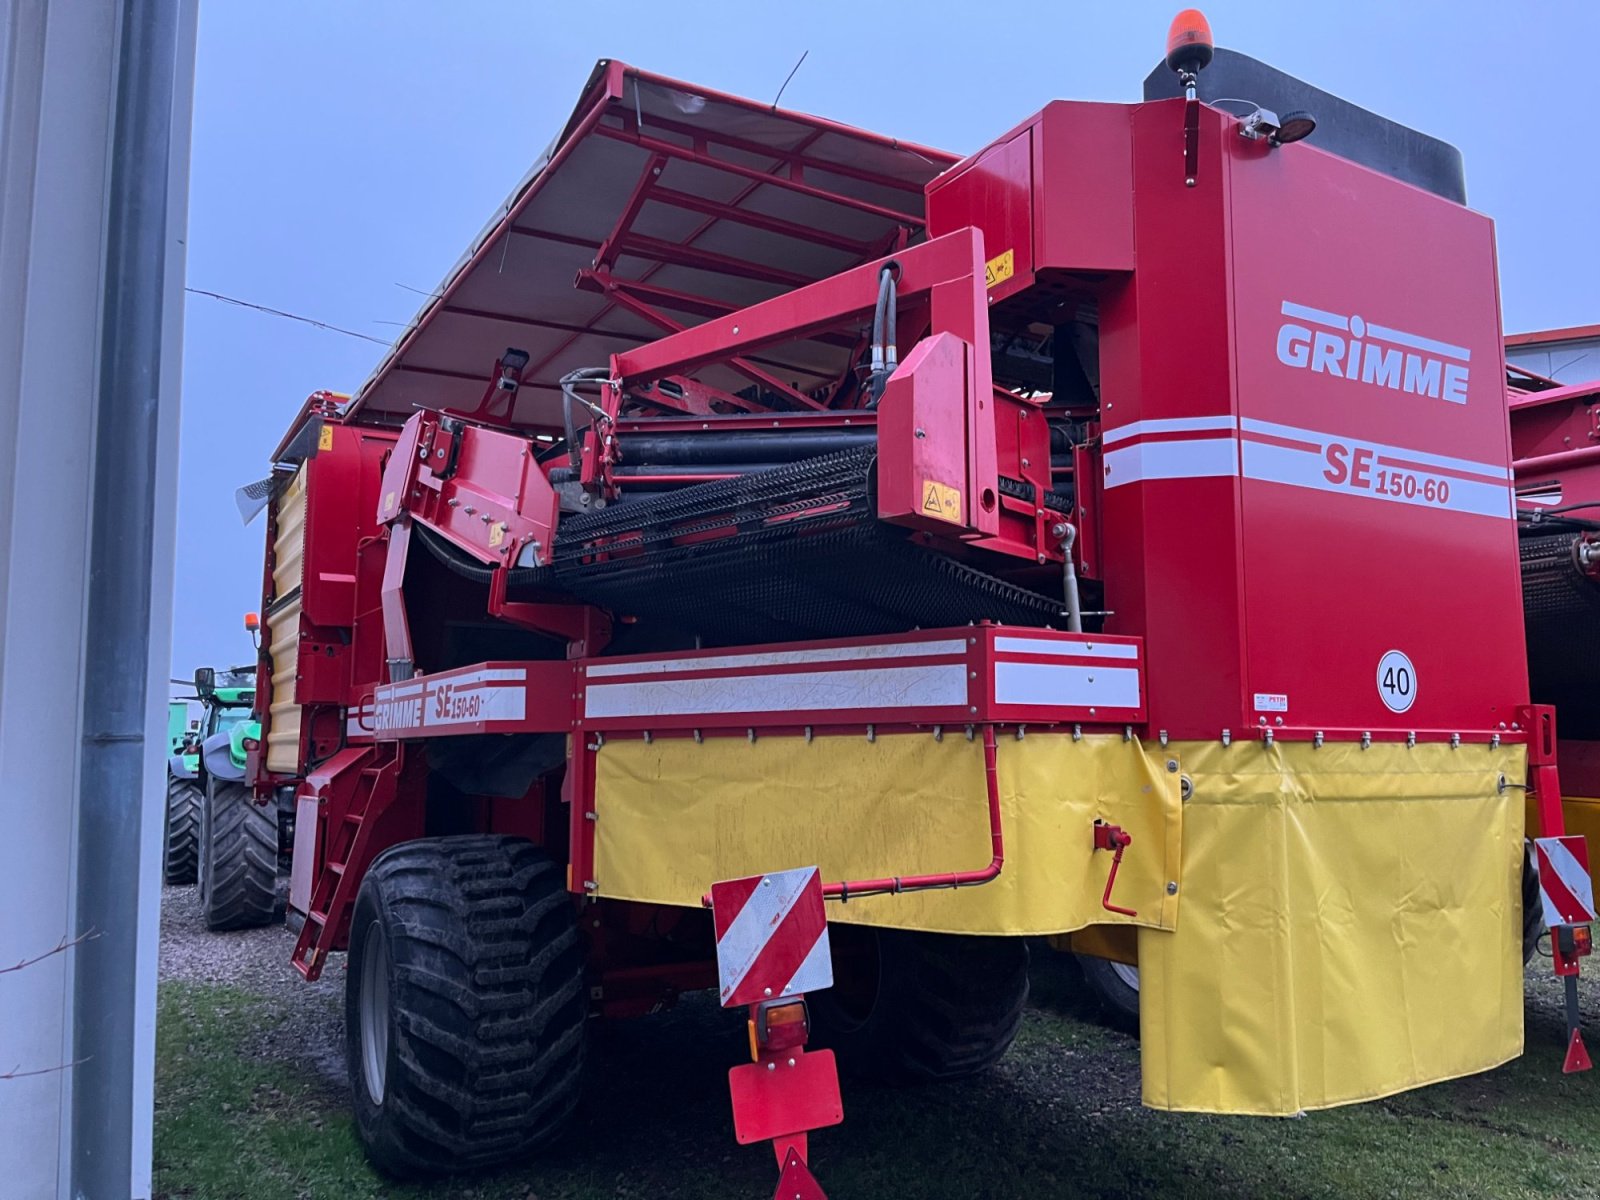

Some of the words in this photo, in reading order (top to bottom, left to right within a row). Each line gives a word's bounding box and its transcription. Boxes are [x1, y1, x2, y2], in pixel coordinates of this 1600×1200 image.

[1276, 314, 1469, 405] GRIMME
[1322, 443, 1374, 489] SE
[1375, 470, 1449, 504] 150-60
[435, 684, 453, 719] SE
[451, 695, 480, 719] 150-60
[1382, 667, 1410, 696] 40
